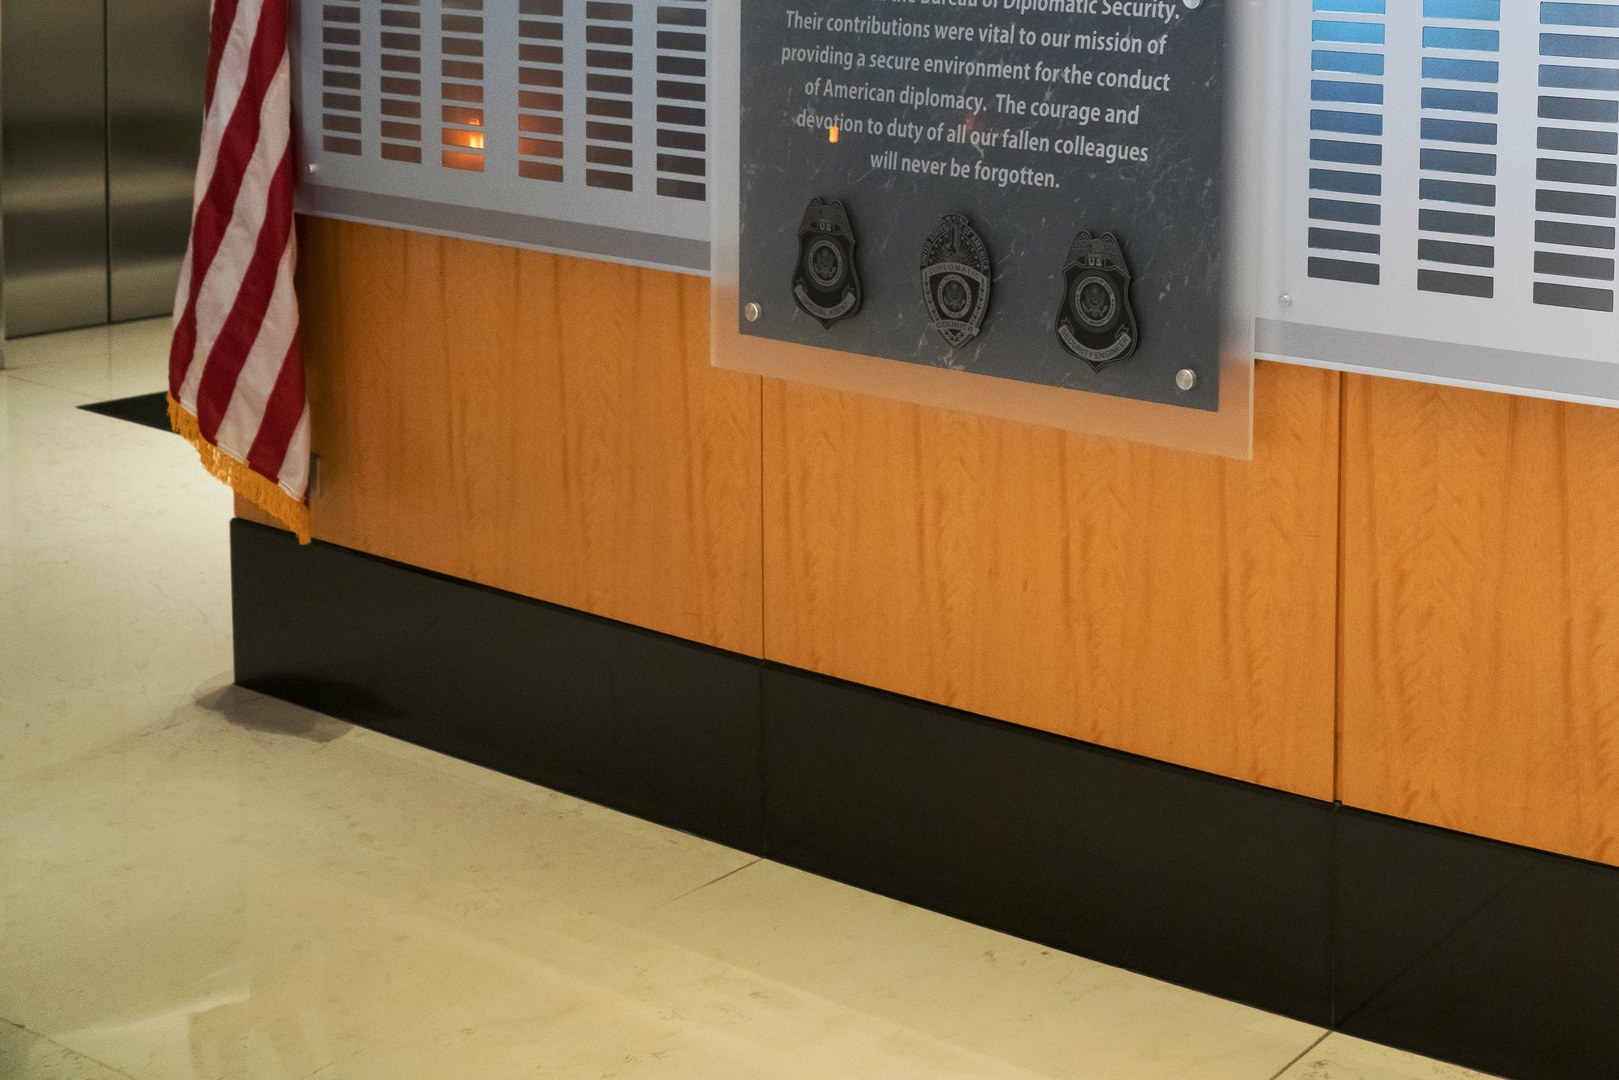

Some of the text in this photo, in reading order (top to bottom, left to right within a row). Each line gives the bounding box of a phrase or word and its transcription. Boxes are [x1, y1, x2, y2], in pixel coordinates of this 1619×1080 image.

[786, 10, 1167, 55] Their contributions were vital to our mission of
[781, 44, 1170, 91] providing a secure environment for the conduct
[804, 78, 1139, 125] of American diplomacy. The courage and
[796, 109, 1149, 164] devotion to duty of all our fallen colleagues
[870, 150, 1060, 189] will never be forgotten.
[920, 224, 989, 271] UNITED STATES OF AMERICA
[929, 263, 981, 280] DIPLOMATIC
[828, 301, 848, 316] AGENT
[936, 321, 973, 333] COURIER
[1061, 327, 1129, 360] SECURITY ENGINEER
